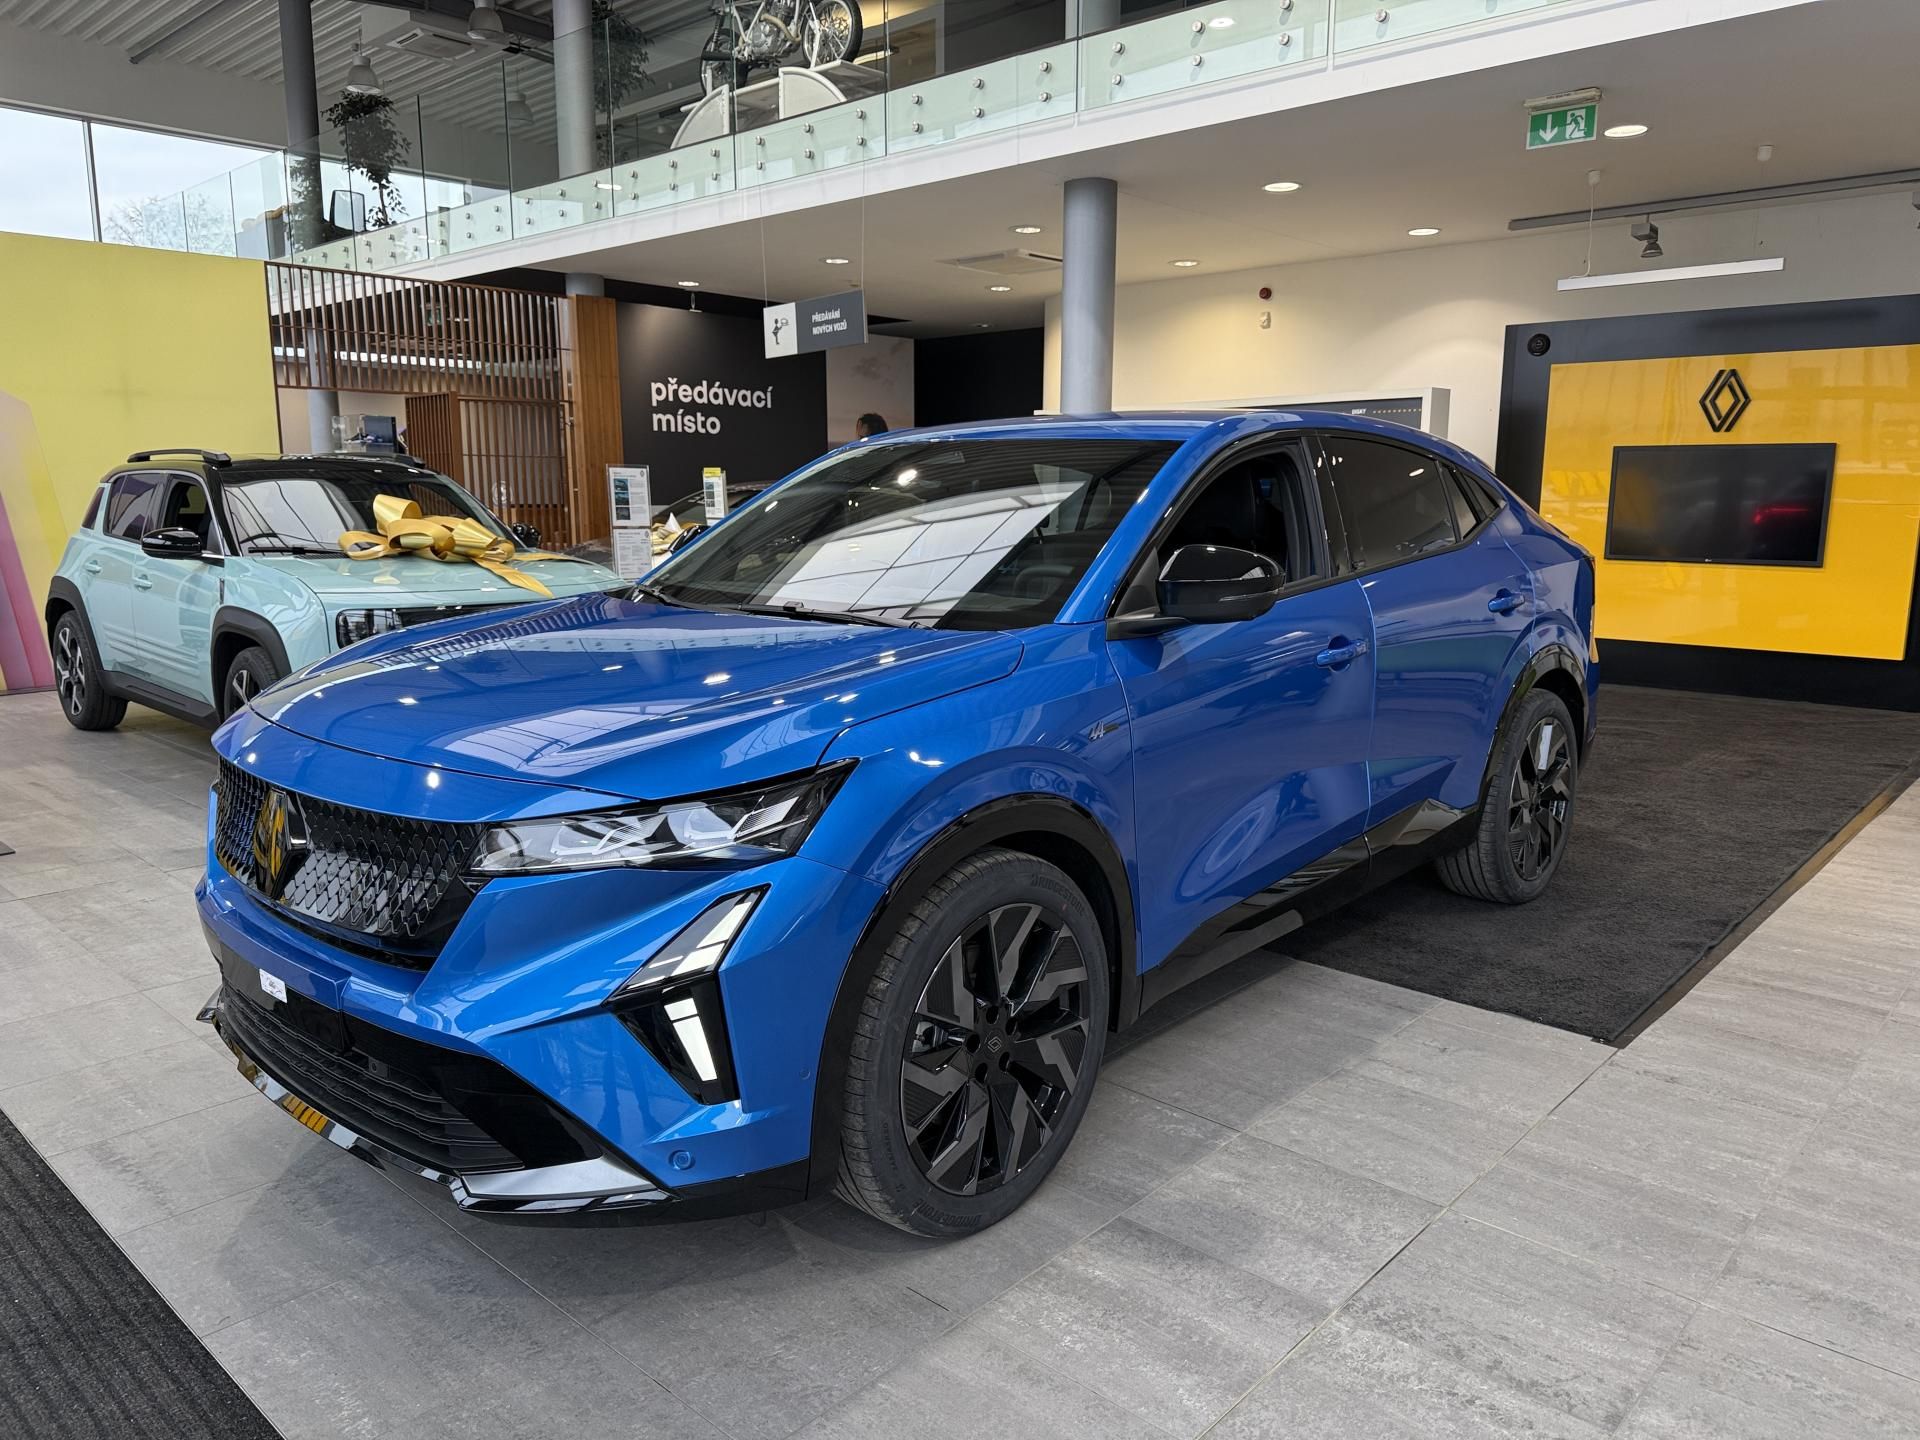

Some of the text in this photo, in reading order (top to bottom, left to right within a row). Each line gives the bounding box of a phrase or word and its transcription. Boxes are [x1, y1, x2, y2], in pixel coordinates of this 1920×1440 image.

[811, 307, 841, 323] PŘEDÁVÁNÍ
[812, 318, 848, 336] NOVÝCH VOZŮ
[651, 377, 773, 408] předávací
[652, 408, 721, 434] místo
